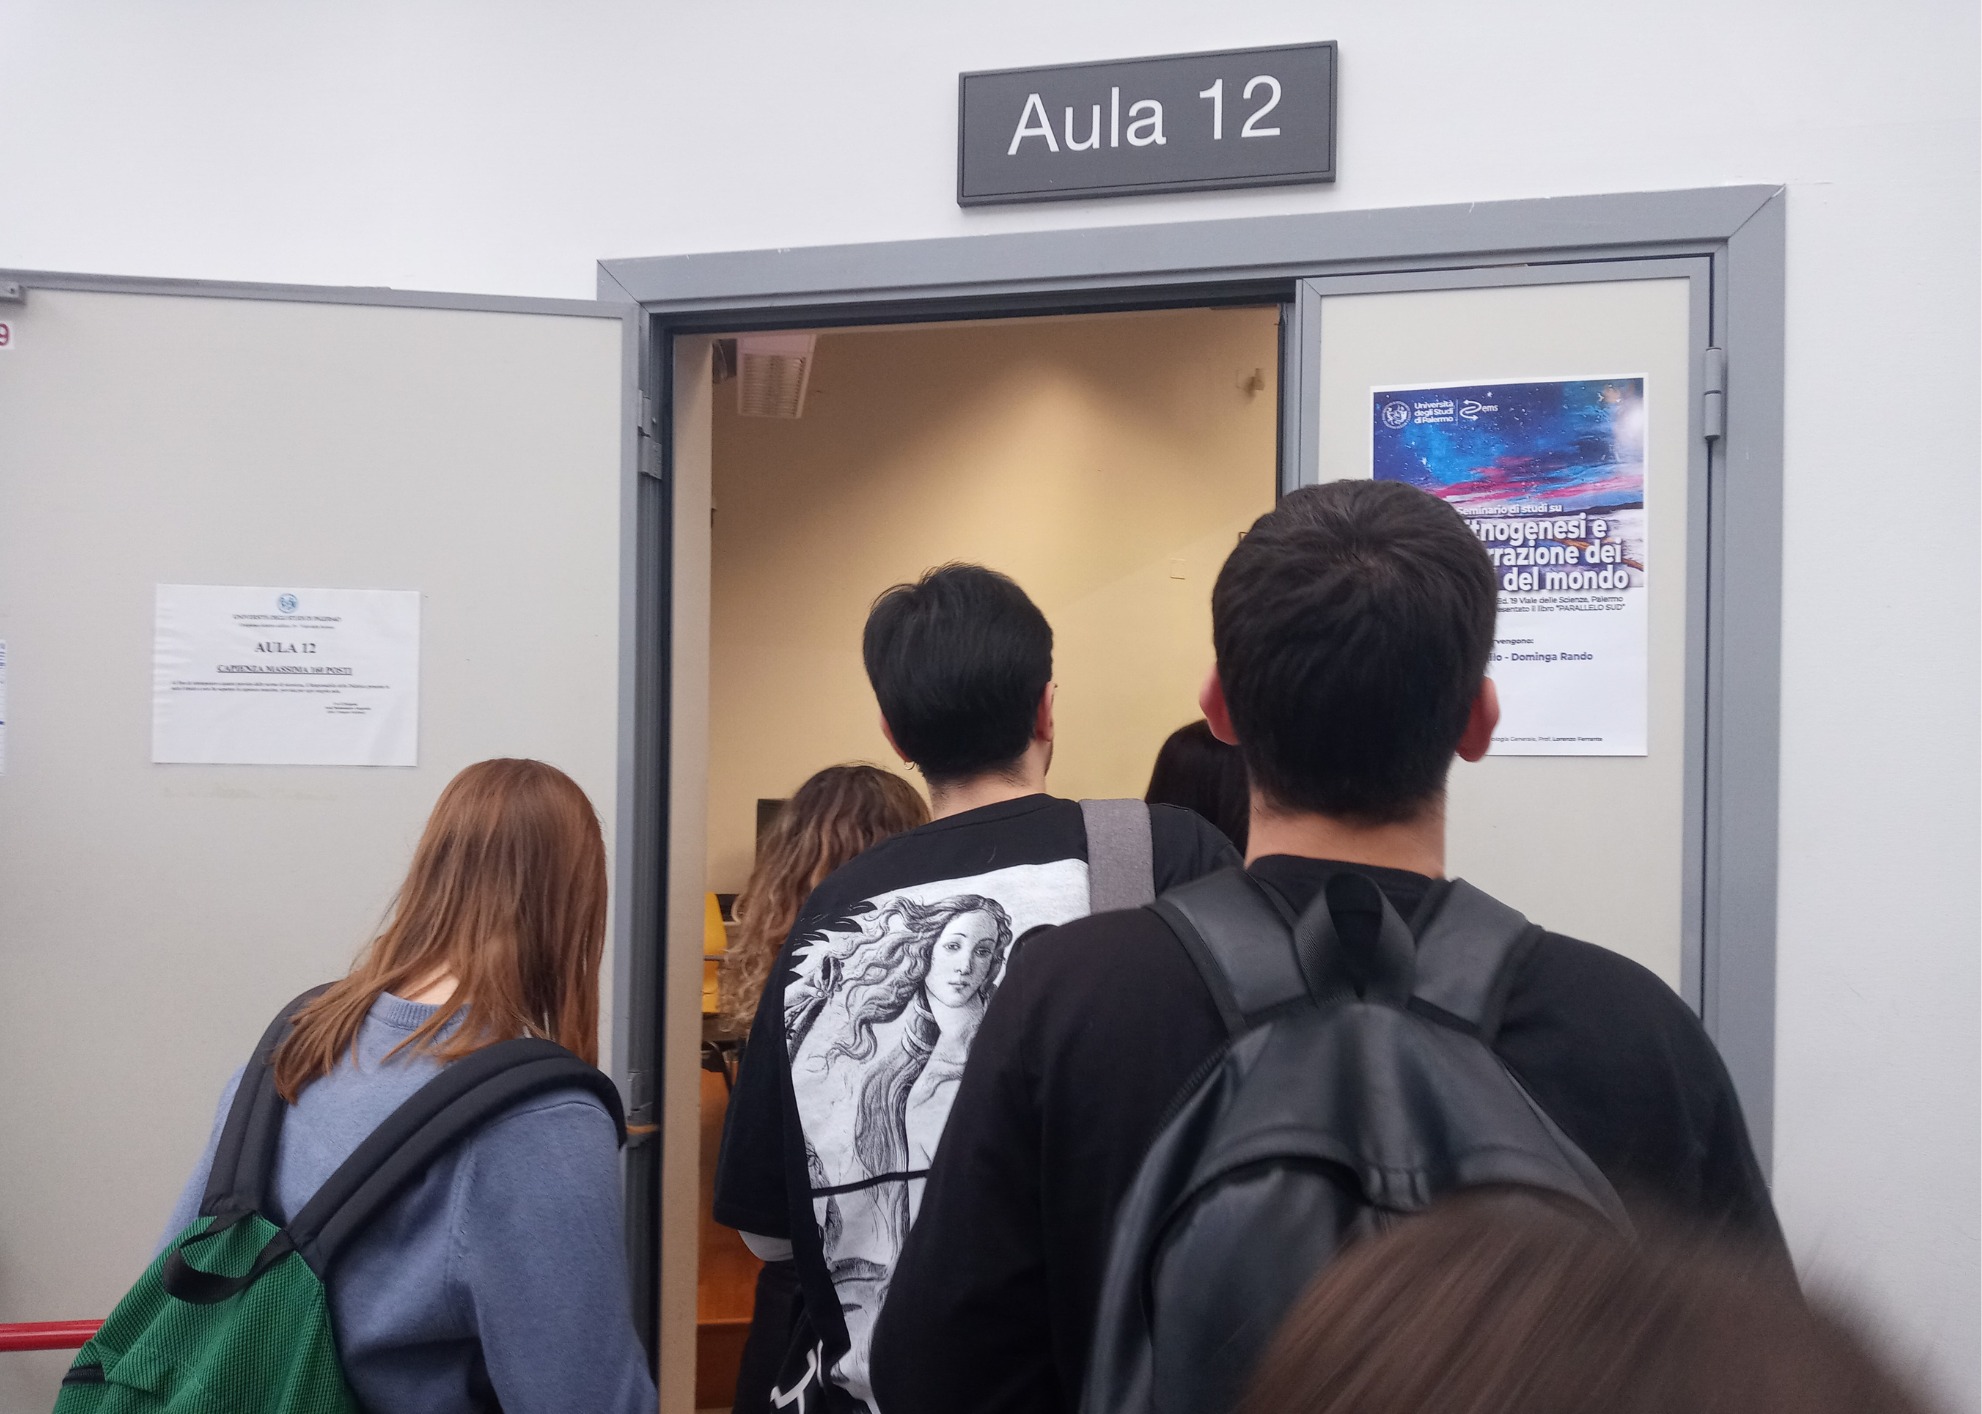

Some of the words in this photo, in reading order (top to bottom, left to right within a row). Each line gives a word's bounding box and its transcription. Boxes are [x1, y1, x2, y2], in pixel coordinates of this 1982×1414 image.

[1007, 86, 1167, 156] Aula
[1199, 75, 1283, 140] 12
[1414, 400, 1454, 410] Università
[1414, 409, 1433, 417] degli
[1433, 408, 1454, 416] Studi
[1423, 416, 1454, 424] Palermo
[1456, 506, 1507, 516] Seminario
[1509, 504, 1520, 515] di
[1521, 504, 1548, 514] studi
[1549, 504, 1562, 513] su
[1464, 513, 1587, 547] tnogenesi
[1592, 518, 1608, 538] e
[1585, 537, 1622, 564] dei
[1503, 567, 1540, 592] del
[1545, 564, 1630, 591] mondo
[1539, 596, 1558, 604] delle
[1591, 595, 1624, 603] Palermo
[1496, 605, 1529, 613] esentato
[254, 641, 298, 654] AULA
[301, 642, 317, 654] 12
[1511, 652, 1557, 663] Dominga
[1560, 652, 1593, 661] Rando
